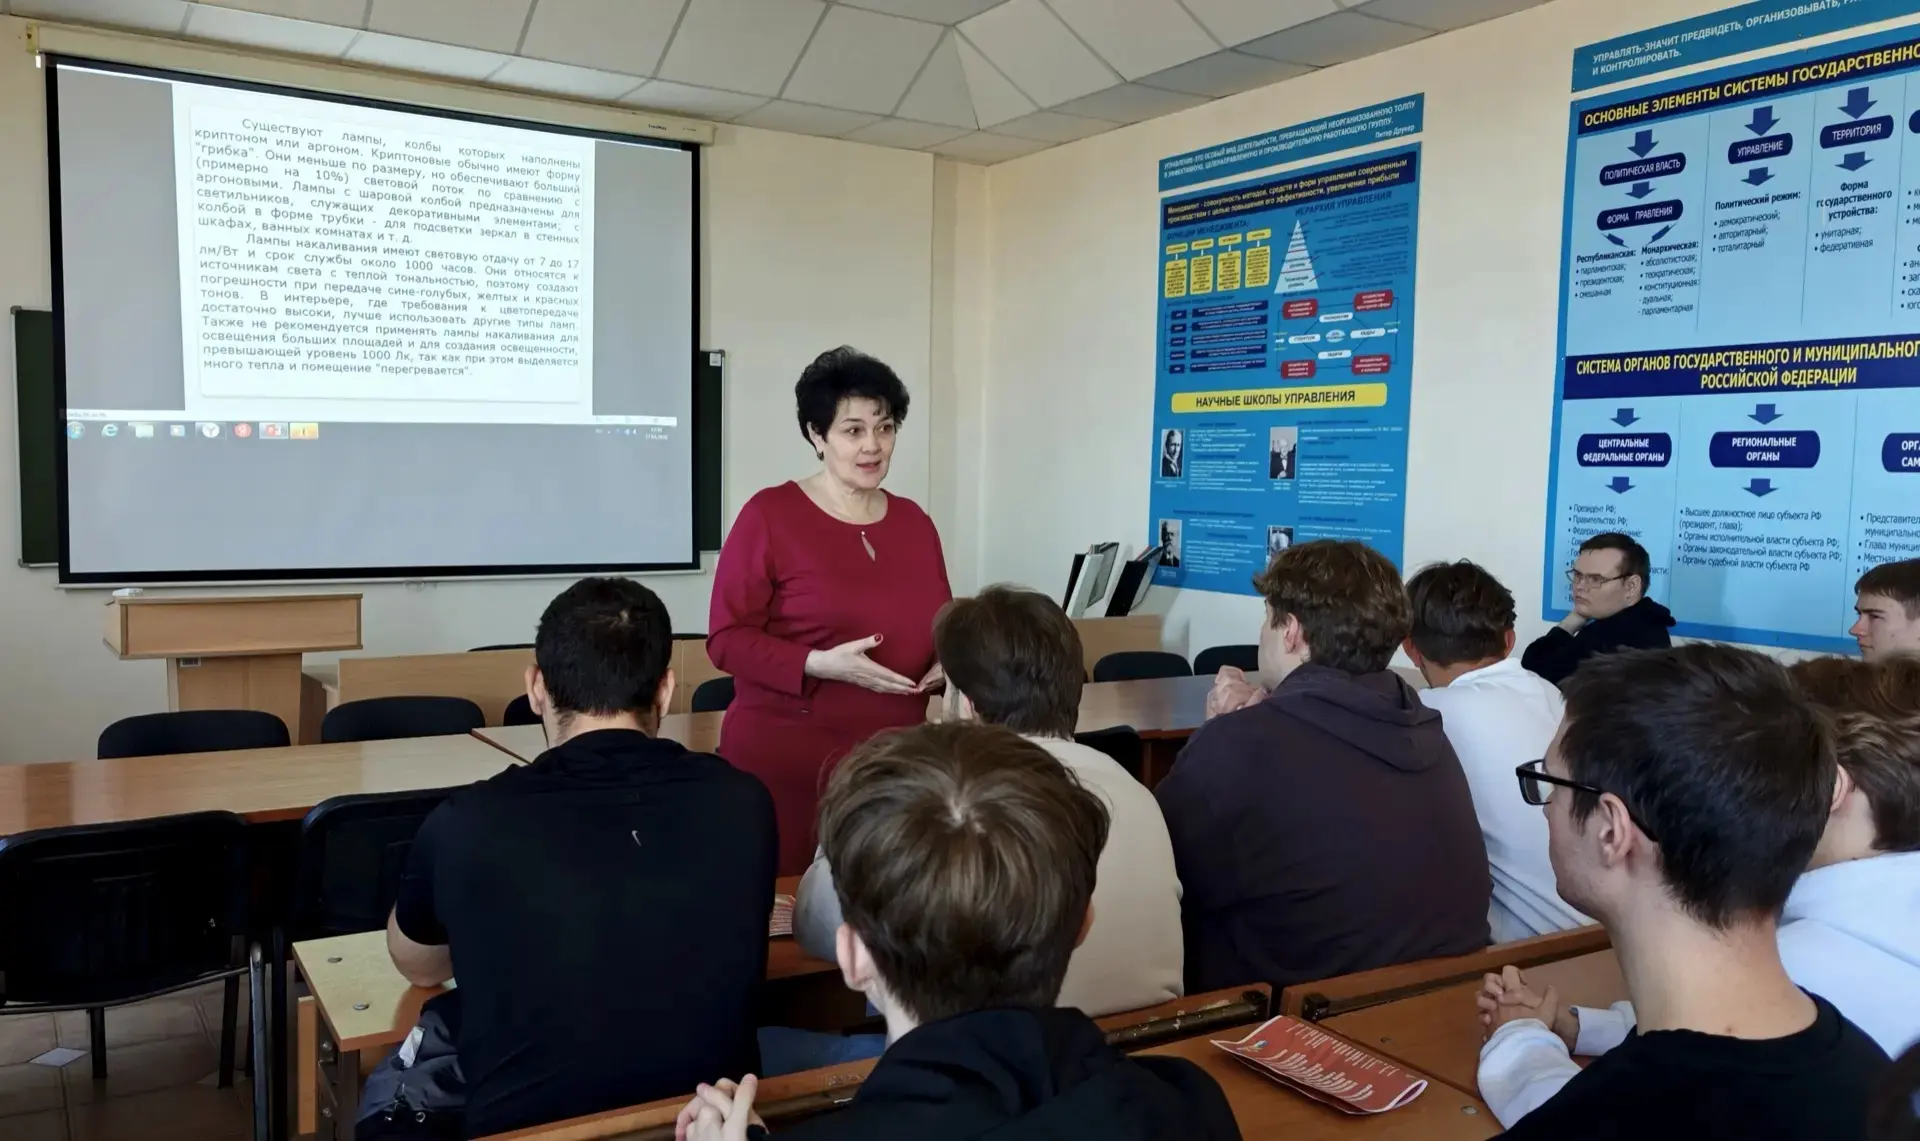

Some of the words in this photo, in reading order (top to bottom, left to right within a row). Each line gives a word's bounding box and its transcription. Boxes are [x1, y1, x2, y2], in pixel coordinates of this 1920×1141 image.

[1592, 35, 1680, 64] УПРАВЛЯТЬ-ЗНАЧИТ
[1681, 21, 1744, 43] ПРЕДВИДЕТЬ,
[1746, 0, 1841, 27] ОРГАНИЗОВЫВАТЬ,
[1592, 66, 1599, 76] И
[1601, 48, 1682, 74] КОНТРОЛИРОВАТЬ.
[1584, 102, 1649, 126] ОСНОВНЫЕ
[1652, 87, 1720, 112] ЭЛЕМЕНТЫ
[1723, 73, 1788, 97] СИСТЕМЫ
[1832, 124, 1881, 141] ТЕРРИТОРИЯ
[242, 118, 324, 138] Существуют
[342, 133, 386, 147] лампы,
[405, 140, 442, 152] колбы
[459, 147, 505, 161] которых
[522, 155, 581, 169] наполнены
[1737, 140, 1783, 157] УПРАВЛЕНИЕ
[195, 128, 268, 144] криптоном
[276, 138, 299, 148] или
[308, 142, 363, 156] аргоном.
[371, 147, 451, 166] Криптоновые
[458, 158, 499, 172] обычно
[506, 166, 540, 177] имеют
[547, 168, 580, 184] форму
[195, 141, 259, 158] "грибка".
[265, 150, 291, 162] Они
[298, 156, 346, 168] меньше
[352, 162, 367, 171] по
[372, 164, 426, 180] размеру,
[432, 171, 445, 179] но
[450, 171, 529, 189] обеспечивают
[534, 179, 580, 194] больший
[1604, 162, 1655, 180] ПОЛИТИЧЕСКАЯ
[1655, 158, 1681, 171] ВЛАСТЬ
[1840, 181, 1868, 192] Форма
[196, 173, 283, 190] аргоновыми.
[292, 181, 336, 195] Лампы
[344, 188, 351, 196] с
[359, 190, 412, 202] шаровой
[420, 195, 461, 207] колбой
[469, 201, 554, 216] предназначены
[561, 209, 580, 219] для
[1715, 193, 1770, 210] Политический
[1771, 192, 1801, 205] режим:
[196, 189, 294, 207] светильников,
[310, 199, 374, 213] служащих
[389, 206, 480, 222] декоративными
[494, 216, 561, 232] элементами;
[575, 223, 580, 231] с
[1607, 212, 1629, 224] ФОРМА
[1635, 205, 1673, 220] ПРАВЛЕНИЯ
[1719, 210, 1781, 228] демократический;
[1828, 205, 1878, 222] устройства:
[1820, 226, 1862, 239] унитарная;
[1641, 241, 1699, 255] Монархическая:
[1717, 238, 1765, 253] тоталитарный
[1820, 240, 1873, 253] федеративная
[1576, 249, 1636, 264] Республиканская:
[200, 260, 278, 273] источникам
[287, 266, 322, 276] света
[330, 269, 337, 277] с
[345, 270, 387, 281] теплой
[395, 274, 478, 289] тональностью,
[486, 280, 530, 293] поэтому
[536, 283, 579, 294] создают
[200, 275, 287, 288] погрешности
[294, 281, 317, 292] при
[324, 283, 382, 295] передаче
[388, 287, 471, 301] сине-голубых,
[477, 292, 517, 302] желтых
[524, 295, 530, 303] и
[535, 295, 579, 306] красных
[203, 315, 244, 327] Также
[251, 320, 267, 329] не
[275, 321, 368, 335] рекомендуется
[376, 326, 437, 337] применять
[443, 329, 479, 338] лампы
[486, 330, 555, 341] накаливания
[560, 333, 579, 343] для
[204, 360, 243, 369] много
[248, 361, 284, 370] тепла
[290, 362, 297, 371] и
[302, 363, 371, 374] помещение
[376, 362, 473, 377] "перегревается".
[1576, 358, 1621, 375] СИСТЕМА
[1624, 355, 1671, 372] ОРГАНОВ
[1674, 349, 1790, 370] ГОСУДАРСТВЕННОГО
[1793, 348, 1802, 363] И
[1701, 367, 1778, 389] РОССИЙСКОЙ
[1781, 368, 1857, 387] ФЕДЕРАЦИИ
[1196, 395, 1241, 407] НАУЧНЫЕ
[1243, 393, 1282, 406] ШКОЛЫ
[1284, 391, 1355, 404] УПРАВЛЕНИЯ
[1598, 438, 1650, 449] ЦЕНТРАЛЬНЫЕ
[1732, 437, 1797, 447] РЕГИОНАЛЬНЫЕ
[1583, 452, 1634, 463] ФЕДЕРАЛЬНЫЕ
[1635, 452, 1665, 462] ОРГАНЫ
[1746, 451, 1780, 461] ОРГАНЫ
[1573, 504, 1604, 515] Президент
[1605, 505, 1616, 515] РФ;
[1685, 508, 1710, 517] Высшее
[1711, 510, 1756, 518] должностное
[1757, 512, 1774, 520] лицо
[1777, 511, 1809, 521] субъекта
[1811, 512, 1822, 520] РФ
[1573, 515, 1616, 525] Правительство
[1617, 516, 1628, 526] РФ;
[1684, 532, 1708, 543] Органы
[1710, 534, 1764, 543] исполнительной
[1766, 537, 1790, 545] власти
[1792, 536, 1824, 547] субъекта
[1826, 538, 1840, 549] РФ;
[1682, 556, 1706, 567] Органы
[1708, 557, 1739, 568] судебной
[1765, 560, 1797, 571] субъекта
[1799, 562, 1810, 571] РФ
